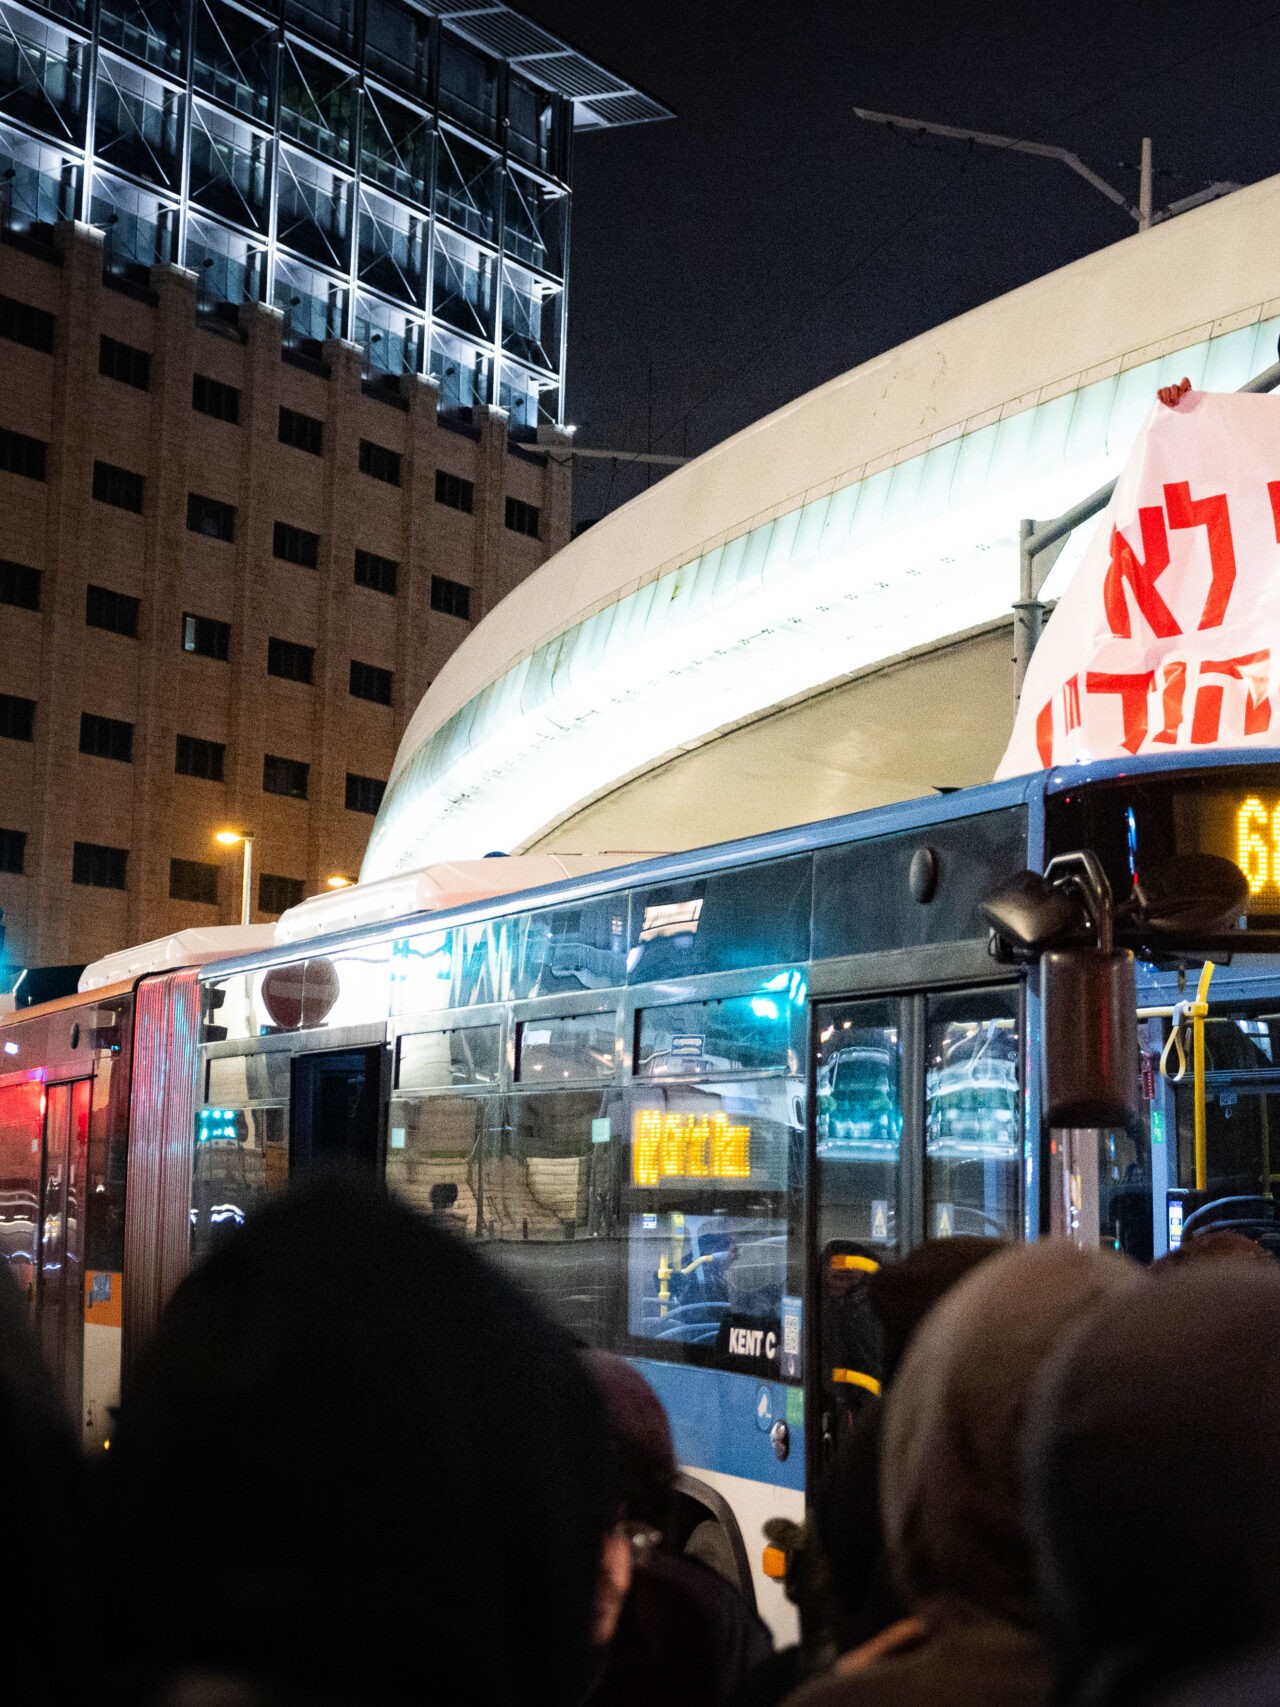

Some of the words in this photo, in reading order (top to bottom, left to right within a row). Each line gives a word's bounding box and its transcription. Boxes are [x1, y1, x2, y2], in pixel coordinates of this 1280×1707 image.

[1103, 481, 1237, 640] לא
[729, 1327, 764, 1357] KENT
[765, 1331, 776, 1360] C
